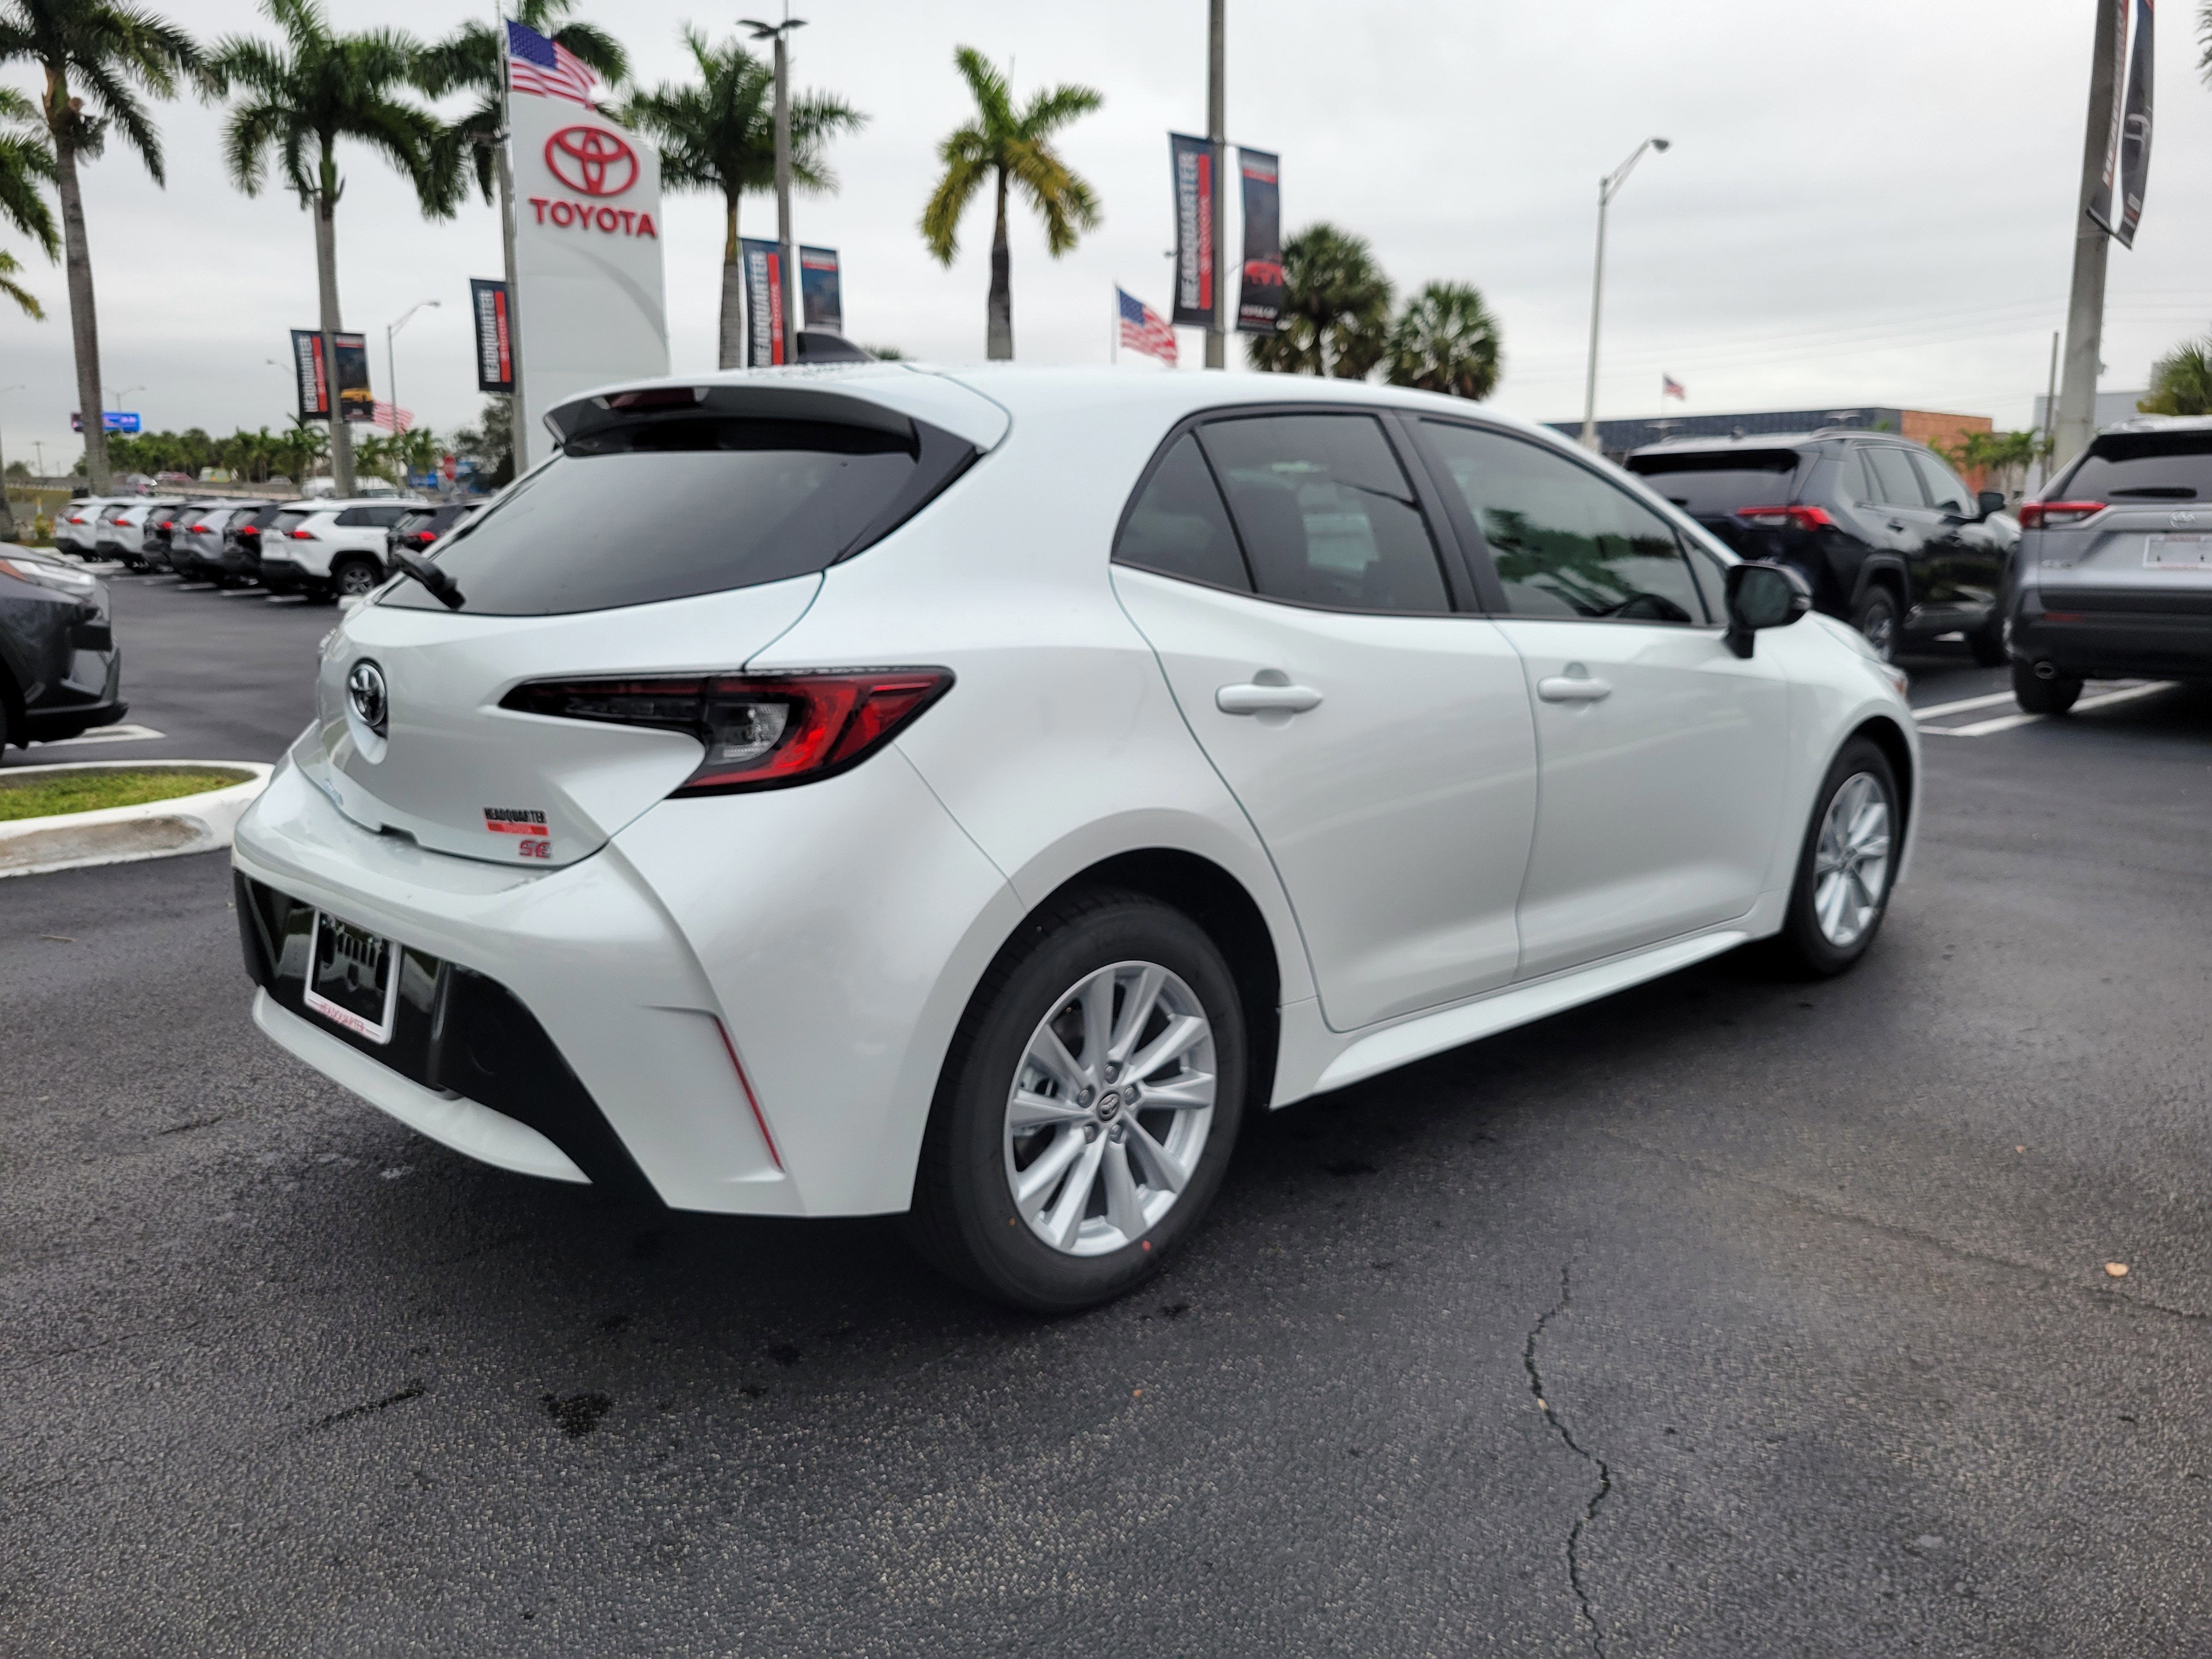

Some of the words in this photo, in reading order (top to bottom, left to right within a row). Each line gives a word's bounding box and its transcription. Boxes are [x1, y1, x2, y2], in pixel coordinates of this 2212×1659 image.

[529, 198, 657, 238] TOYOTA
[1179, 152, 1199, 308] HEADQUARTER
[478, 290, 500, 382] HEADQUARTER
[749, 251, 771, 366] HEADQUARTER
[484, 808, 547, 823] HEADQUARTER
[520, 840, 550, 859] SE
